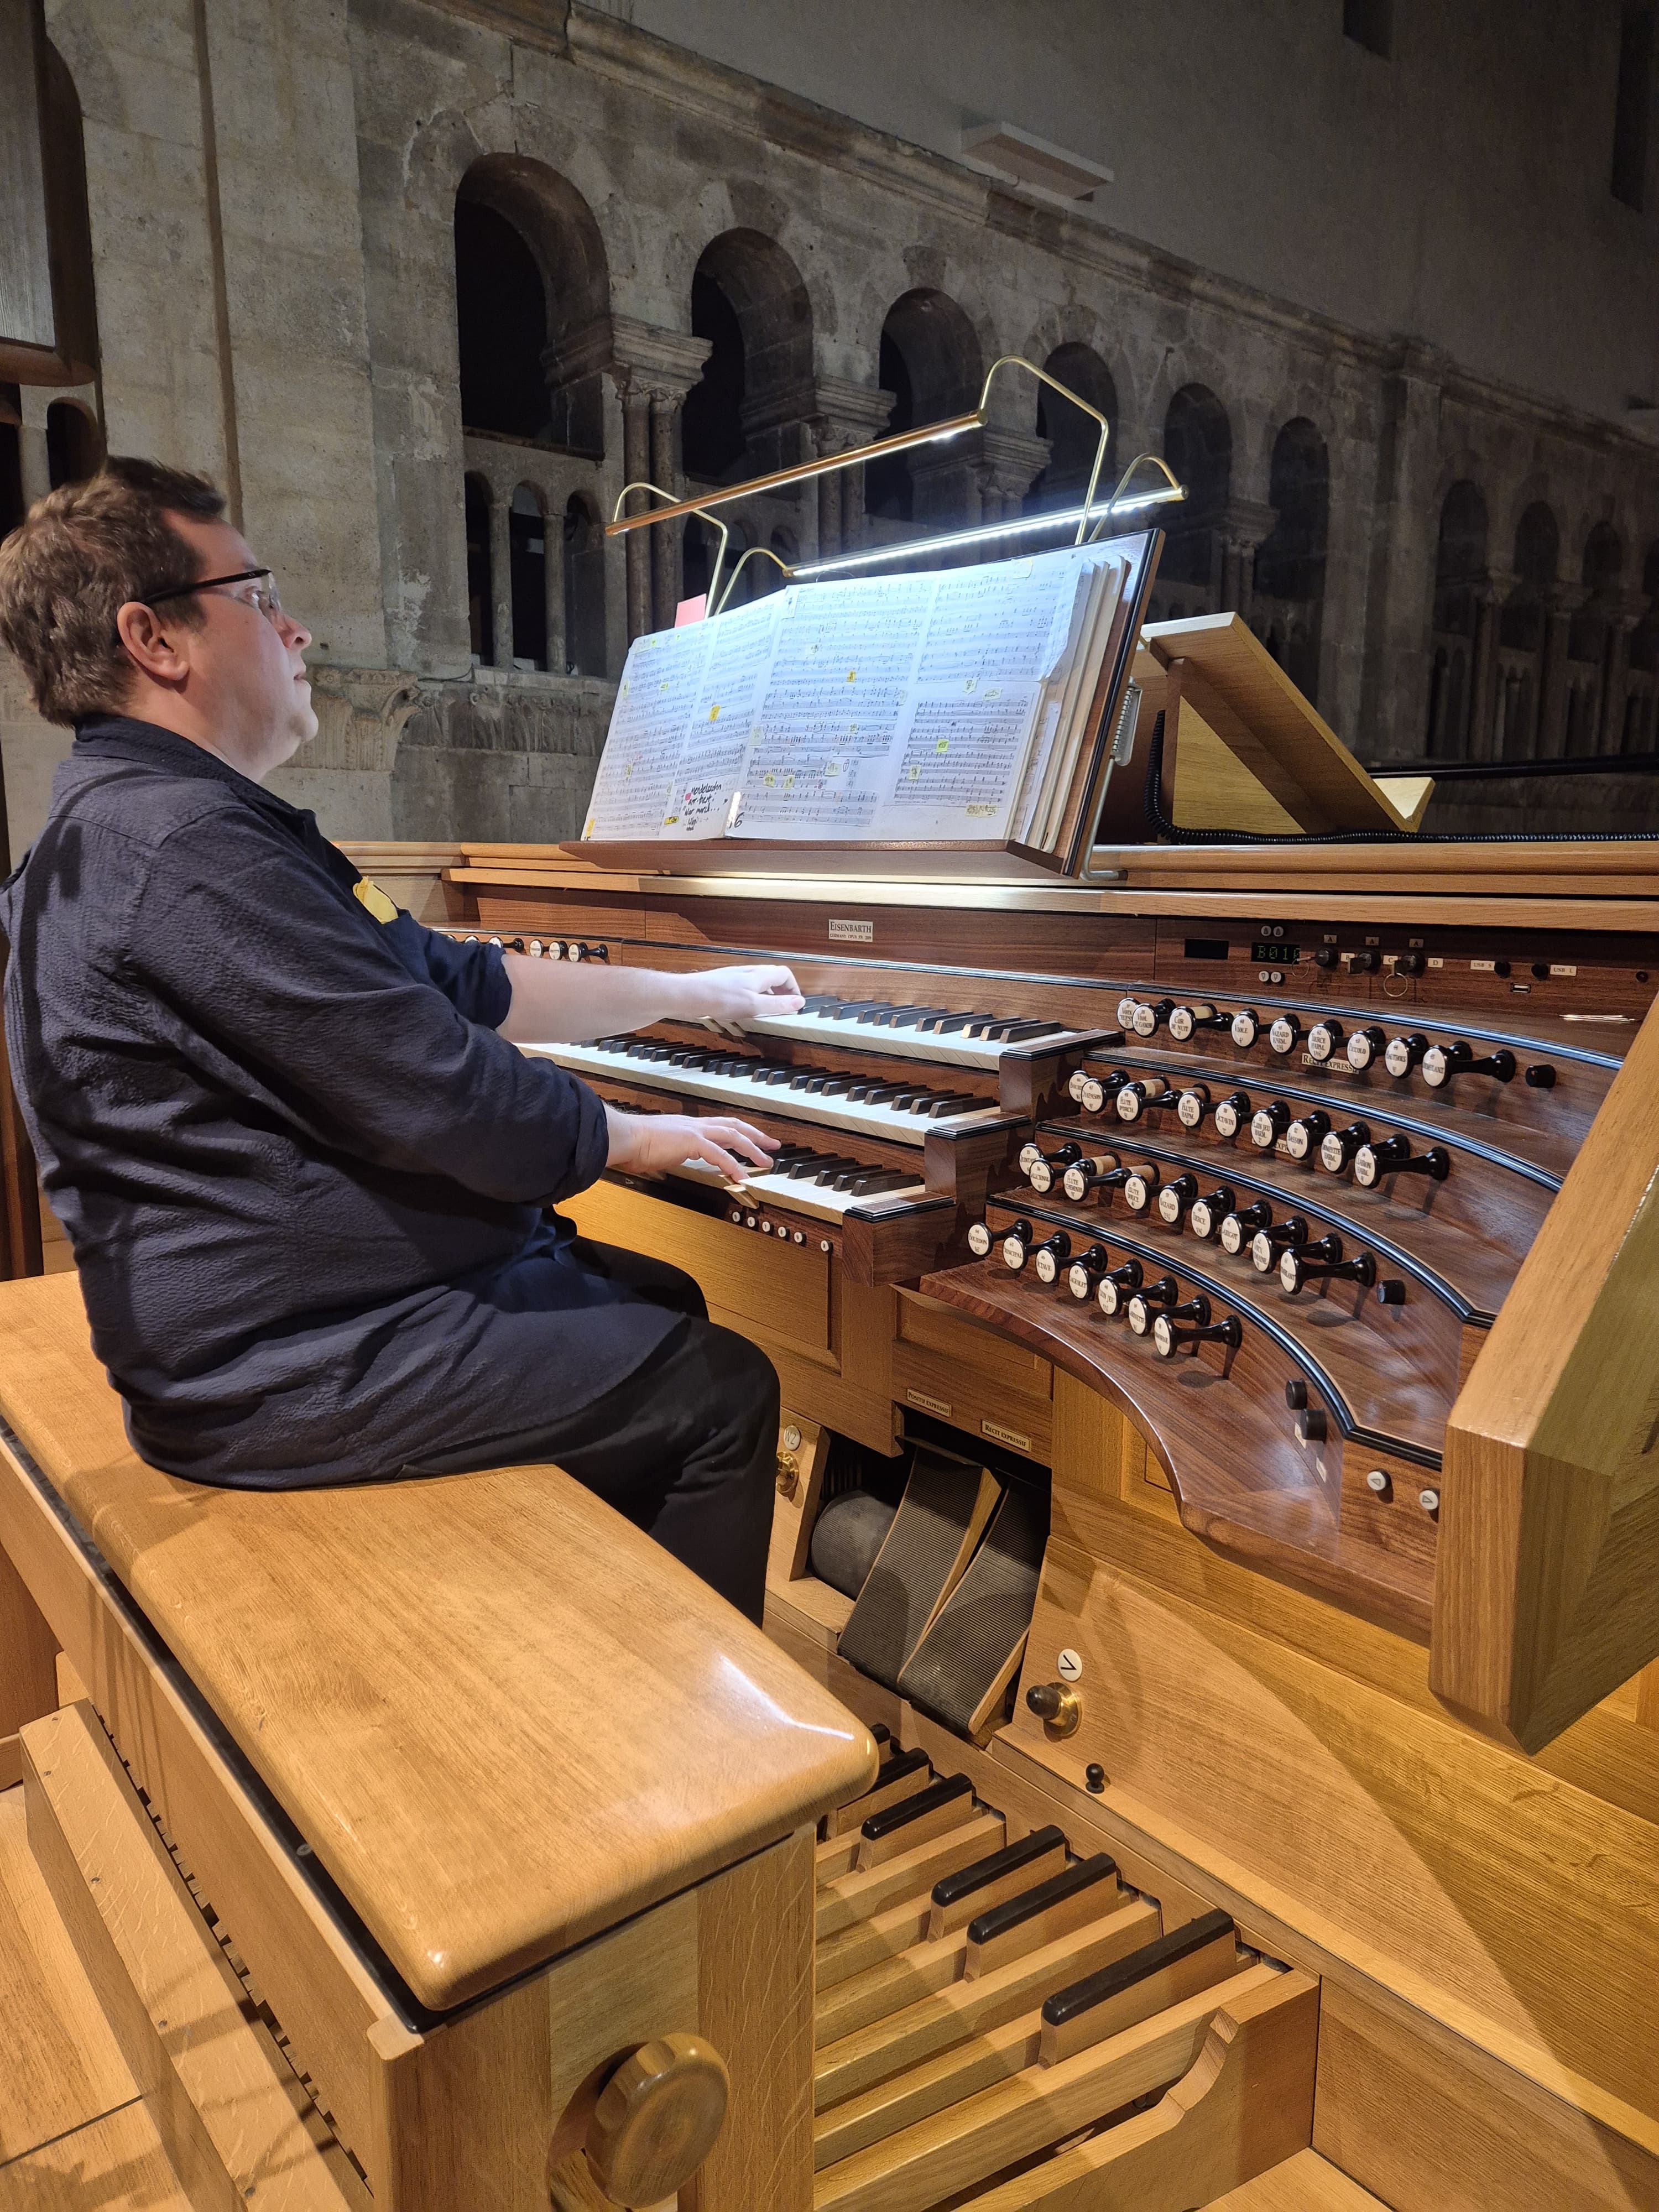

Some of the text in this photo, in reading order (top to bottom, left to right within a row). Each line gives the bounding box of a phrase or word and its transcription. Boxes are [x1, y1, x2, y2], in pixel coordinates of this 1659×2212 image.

[830, 921, 872, 933] EISENBARTH
[1174, 1015, 1185, 1024] COR
[1234, 1024, 1248, 1034] VIOLE
[1326, 1058, 1357, 1073] EXPRESS
[1181, 1102, 1194, 1113] FLUTE
[1287, 1132, 1303, 1145] BASSON
[969, 1233, 987, 1245] BOURDON
[985, 1423, 1027, 1448] RECIT EXPRESSIF
